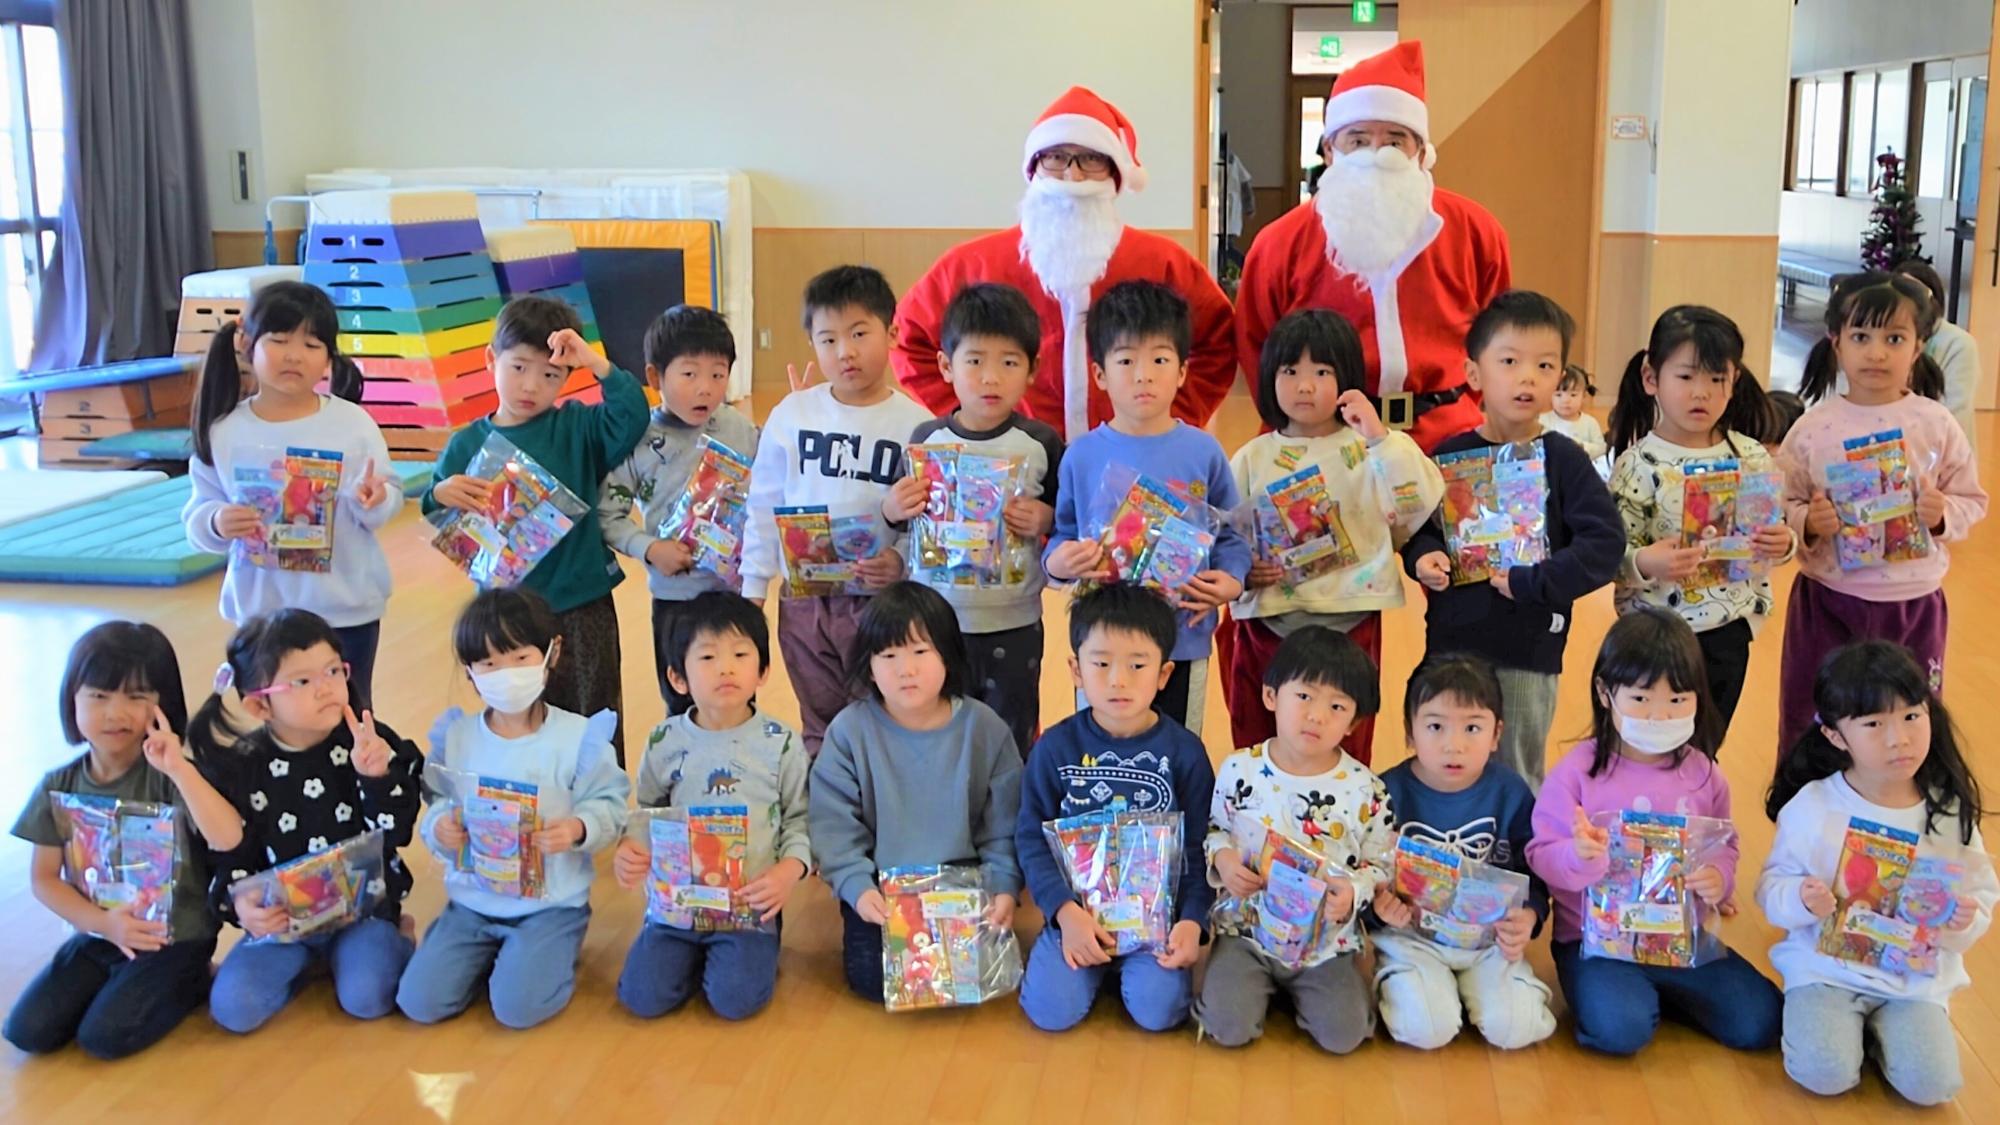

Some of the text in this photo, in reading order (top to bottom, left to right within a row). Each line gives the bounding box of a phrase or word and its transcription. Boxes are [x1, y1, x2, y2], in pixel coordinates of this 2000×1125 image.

[347, 234, 357, 249] 1
[349, 265, 359, 280] 2
[351, 289, 361, 303] 3
[351, 313, 362, 329] 4
[798, 430, 902, 485] POLO
